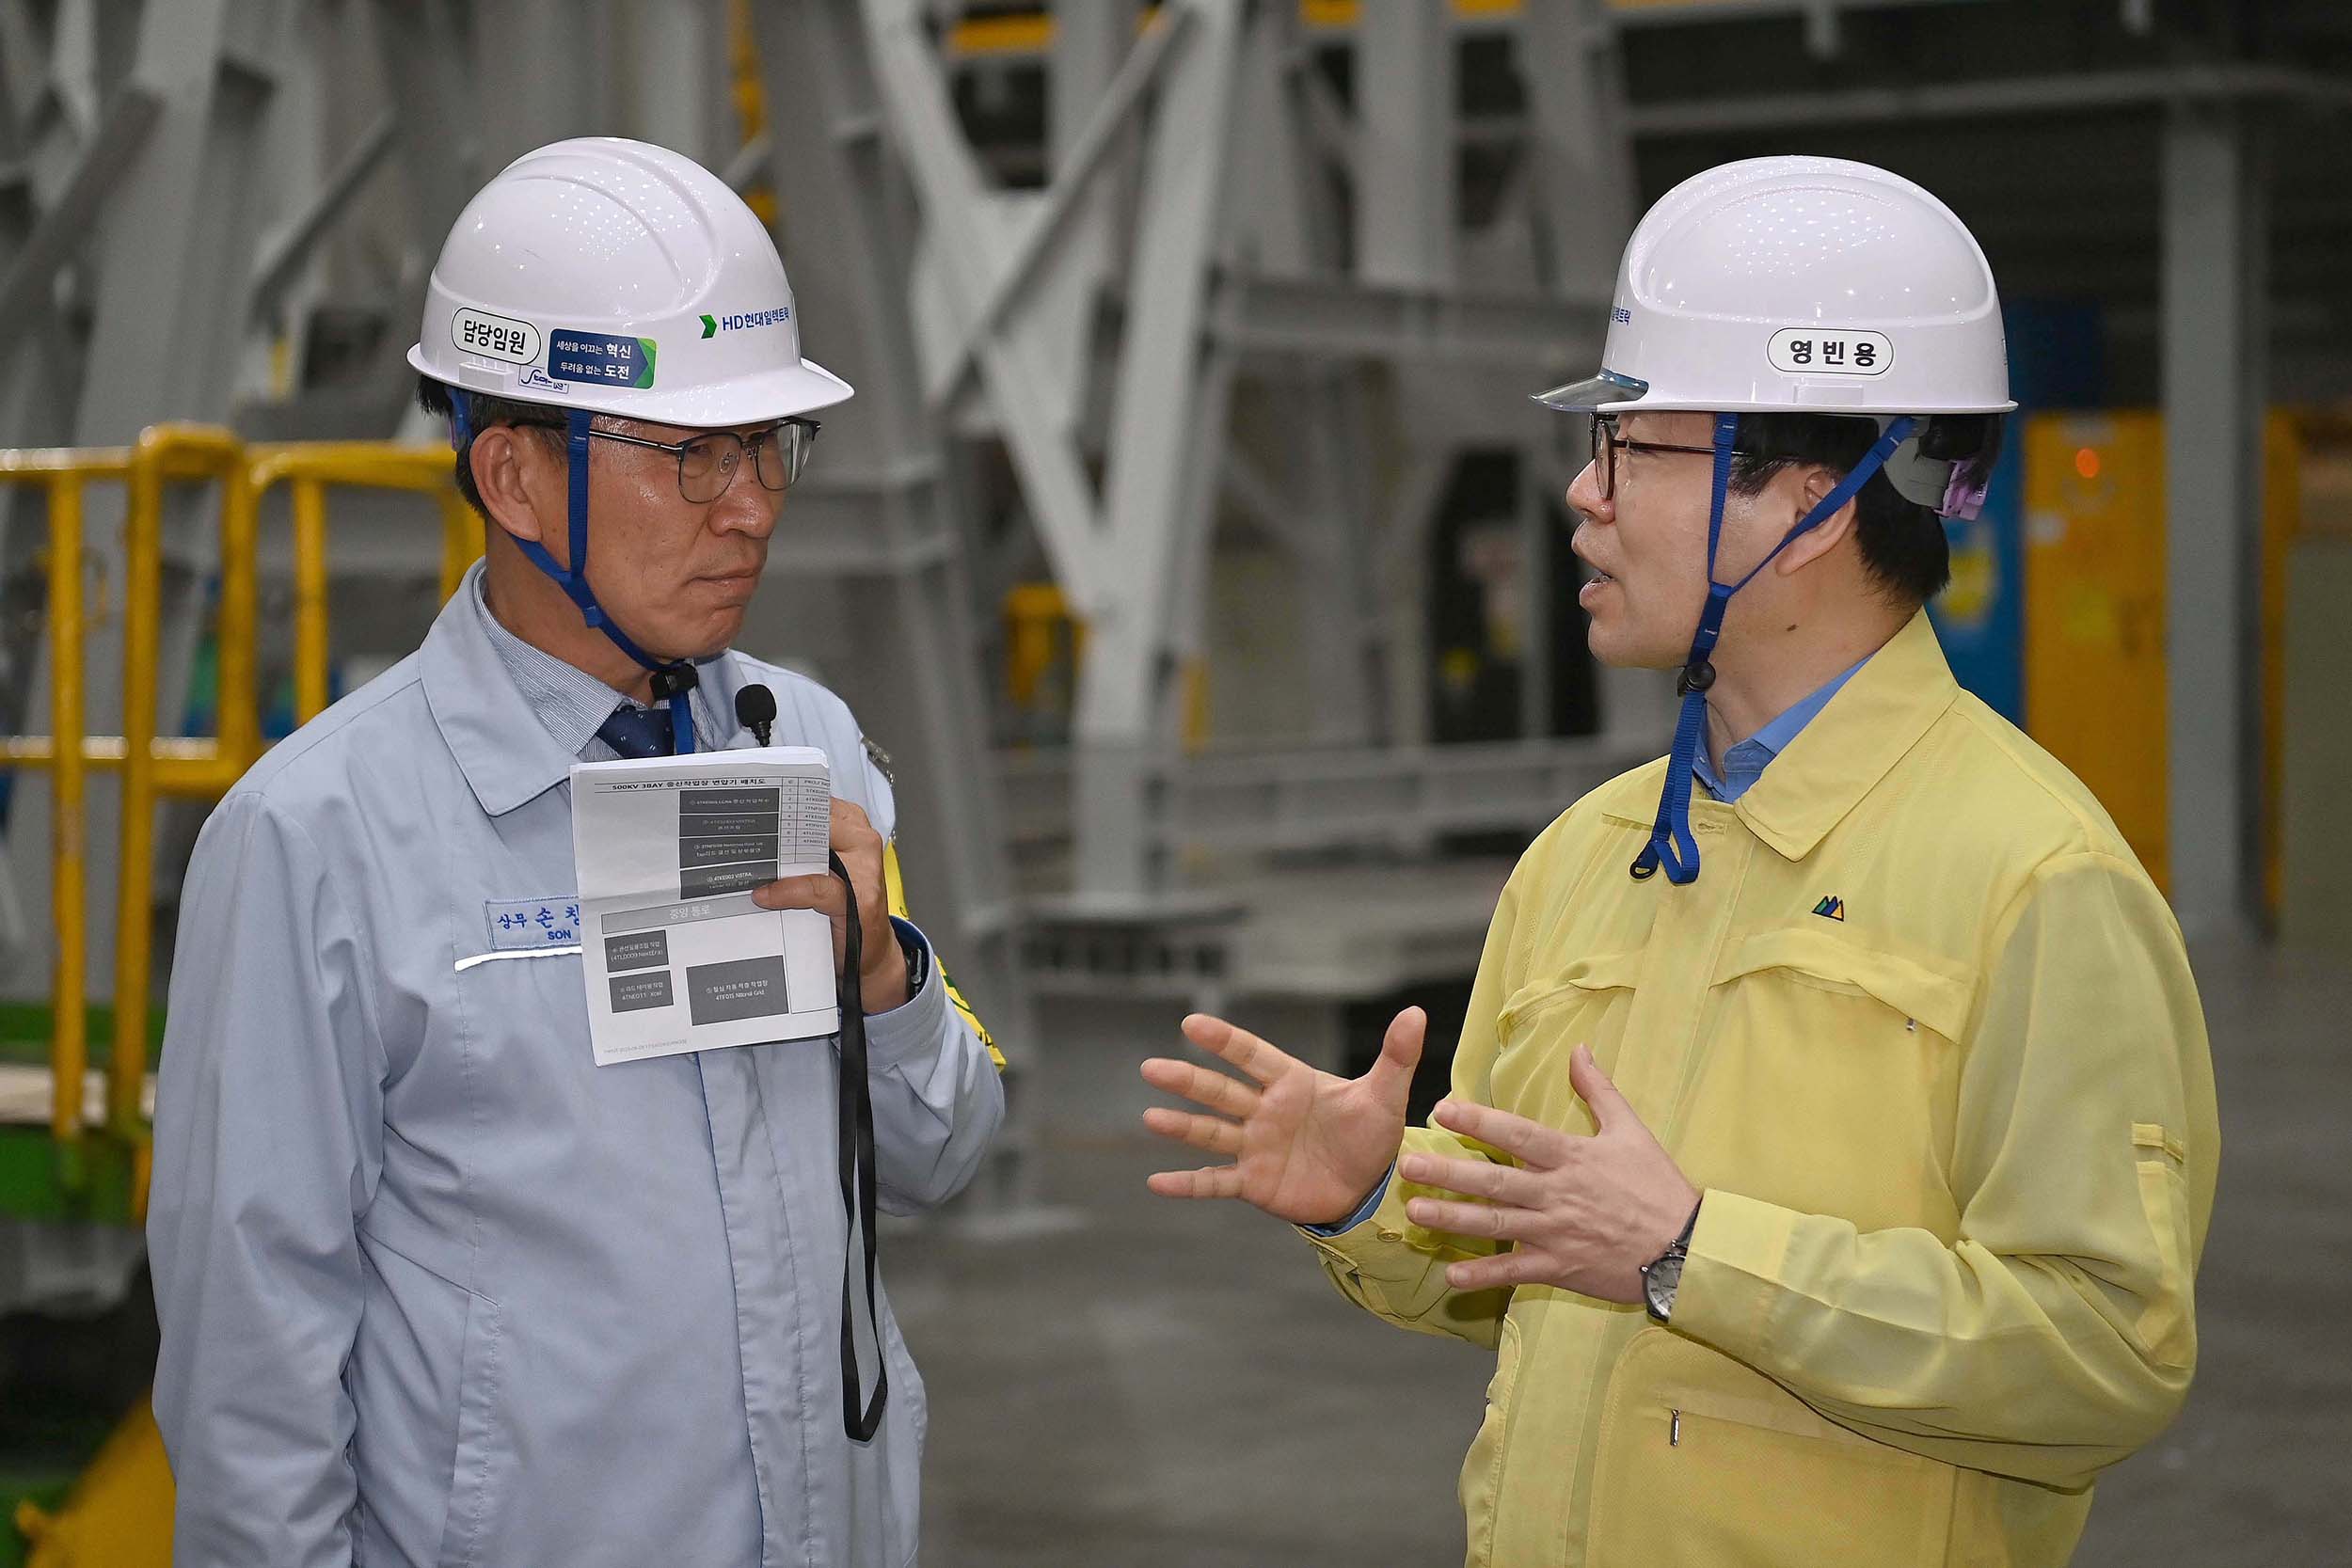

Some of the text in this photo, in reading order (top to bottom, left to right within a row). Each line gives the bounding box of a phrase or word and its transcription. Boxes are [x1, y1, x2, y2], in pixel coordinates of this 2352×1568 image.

[722, 307, 789, 331] HD현대일렉트릭
[464, 320, 526, 356] 담당임원
[556, 341, 579, 353] 세상을
[606, 342, 631, 359] 혁신
[1789, 340, 1877, 367] 영빈용
[560, 361, 629, 380] 두려움 없는 도전
[497, 912, 527, 929] 상무
[534, 907, 554, 928] 손
[548, 929, 572, 941] SON
